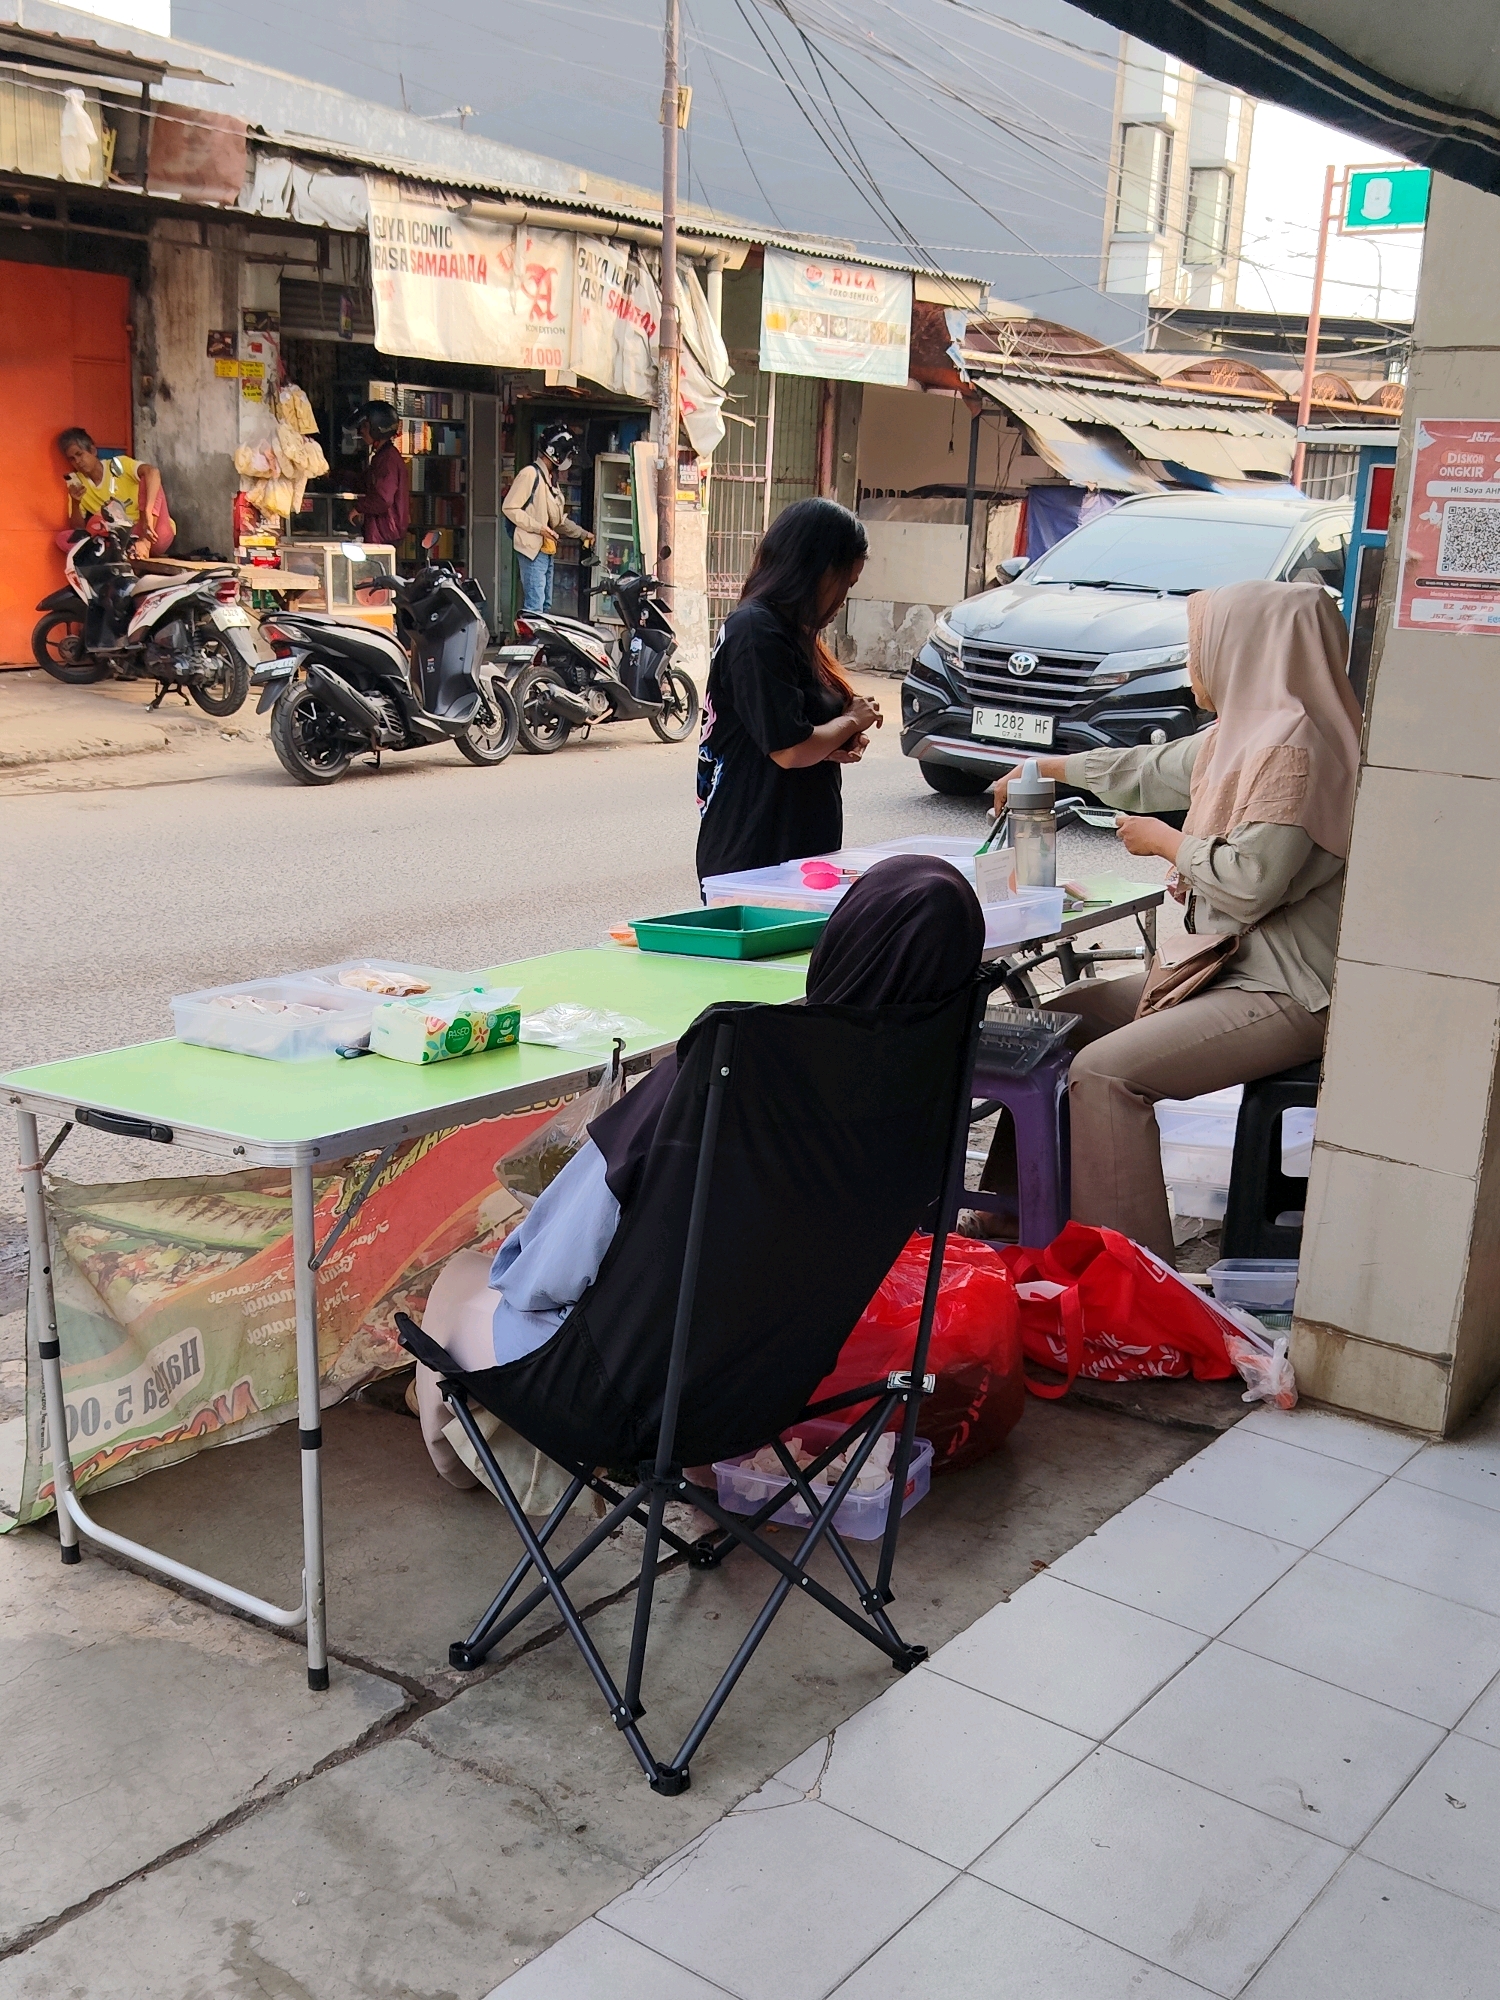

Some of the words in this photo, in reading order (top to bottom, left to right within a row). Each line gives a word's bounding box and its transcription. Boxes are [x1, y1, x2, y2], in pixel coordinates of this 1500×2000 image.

[408, 220, 453, 249] ICONIC
[374, 244, 409, 273] RASA
[829, 288, 848, 299] TOKO
[1466, 432, 1494, 443] J&T
[1447, 452, 1484, 464] DISKON
[1439, 467, 1485, 478] ONGKIR
[1450, 486, 1461, 494] Hi!
[1464, 486, 1483, 496] Saya
[976, 711, 984, 725] R
[994, 713, 1024, 732] 1282
[1034, 718, 1049, 733] HF
[448, 1026, 470, 1038] PASEO
